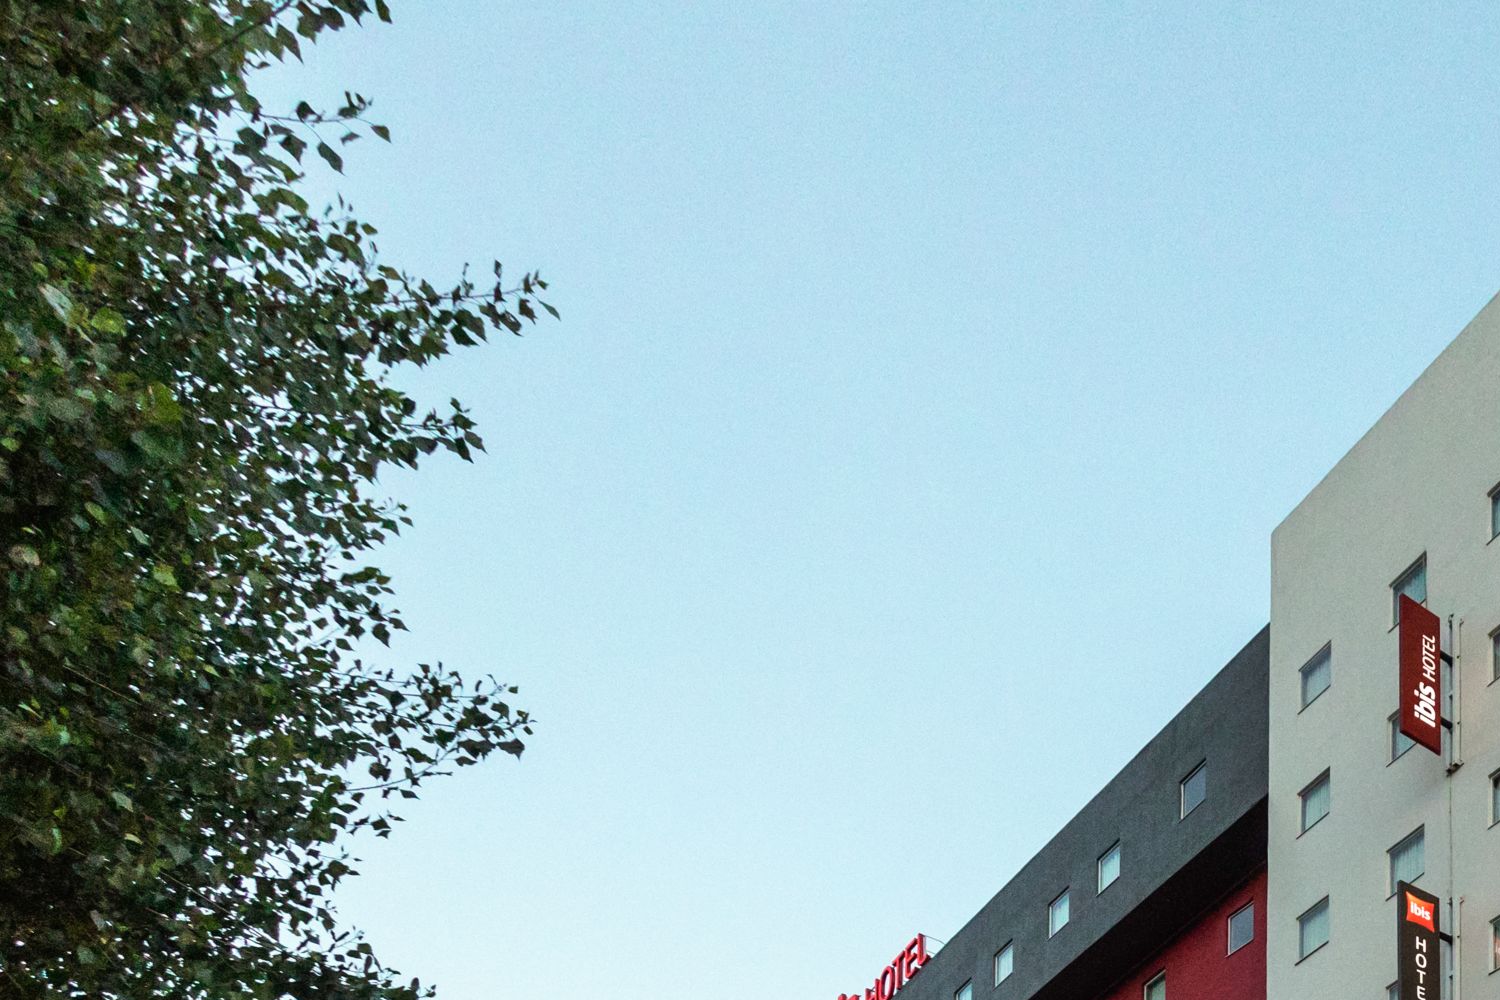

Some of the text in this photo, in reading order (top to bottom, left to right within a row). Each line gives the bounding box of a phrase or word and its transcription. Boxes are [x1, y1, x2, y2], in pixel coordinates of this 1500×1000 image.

[1413, 634, 1436, 728] ibis HOTEL
[1410, 901, 1431, 921] ibis
